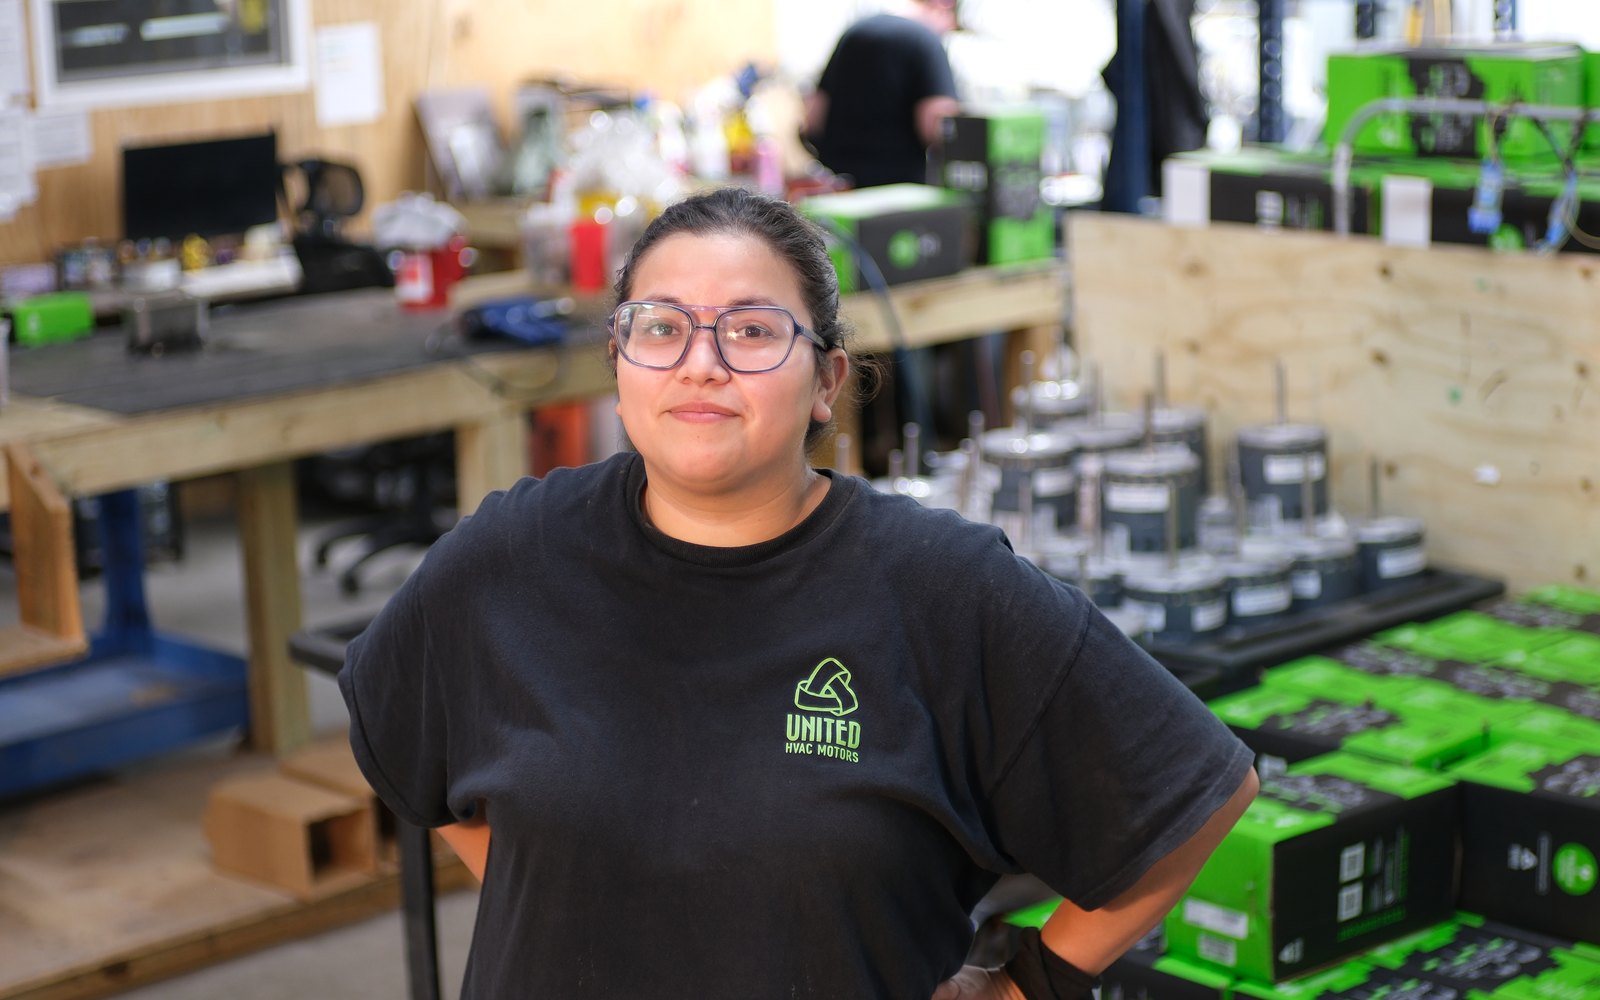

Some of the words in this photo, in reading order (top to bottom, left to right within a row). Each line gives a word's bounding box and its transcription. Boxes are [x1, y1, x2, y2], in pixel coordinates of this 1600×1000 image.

[786, 714, 861, 749] UNITED
[785, 742, 813, 754] HVAC
[817, 744, 859, 763] MOTORS
